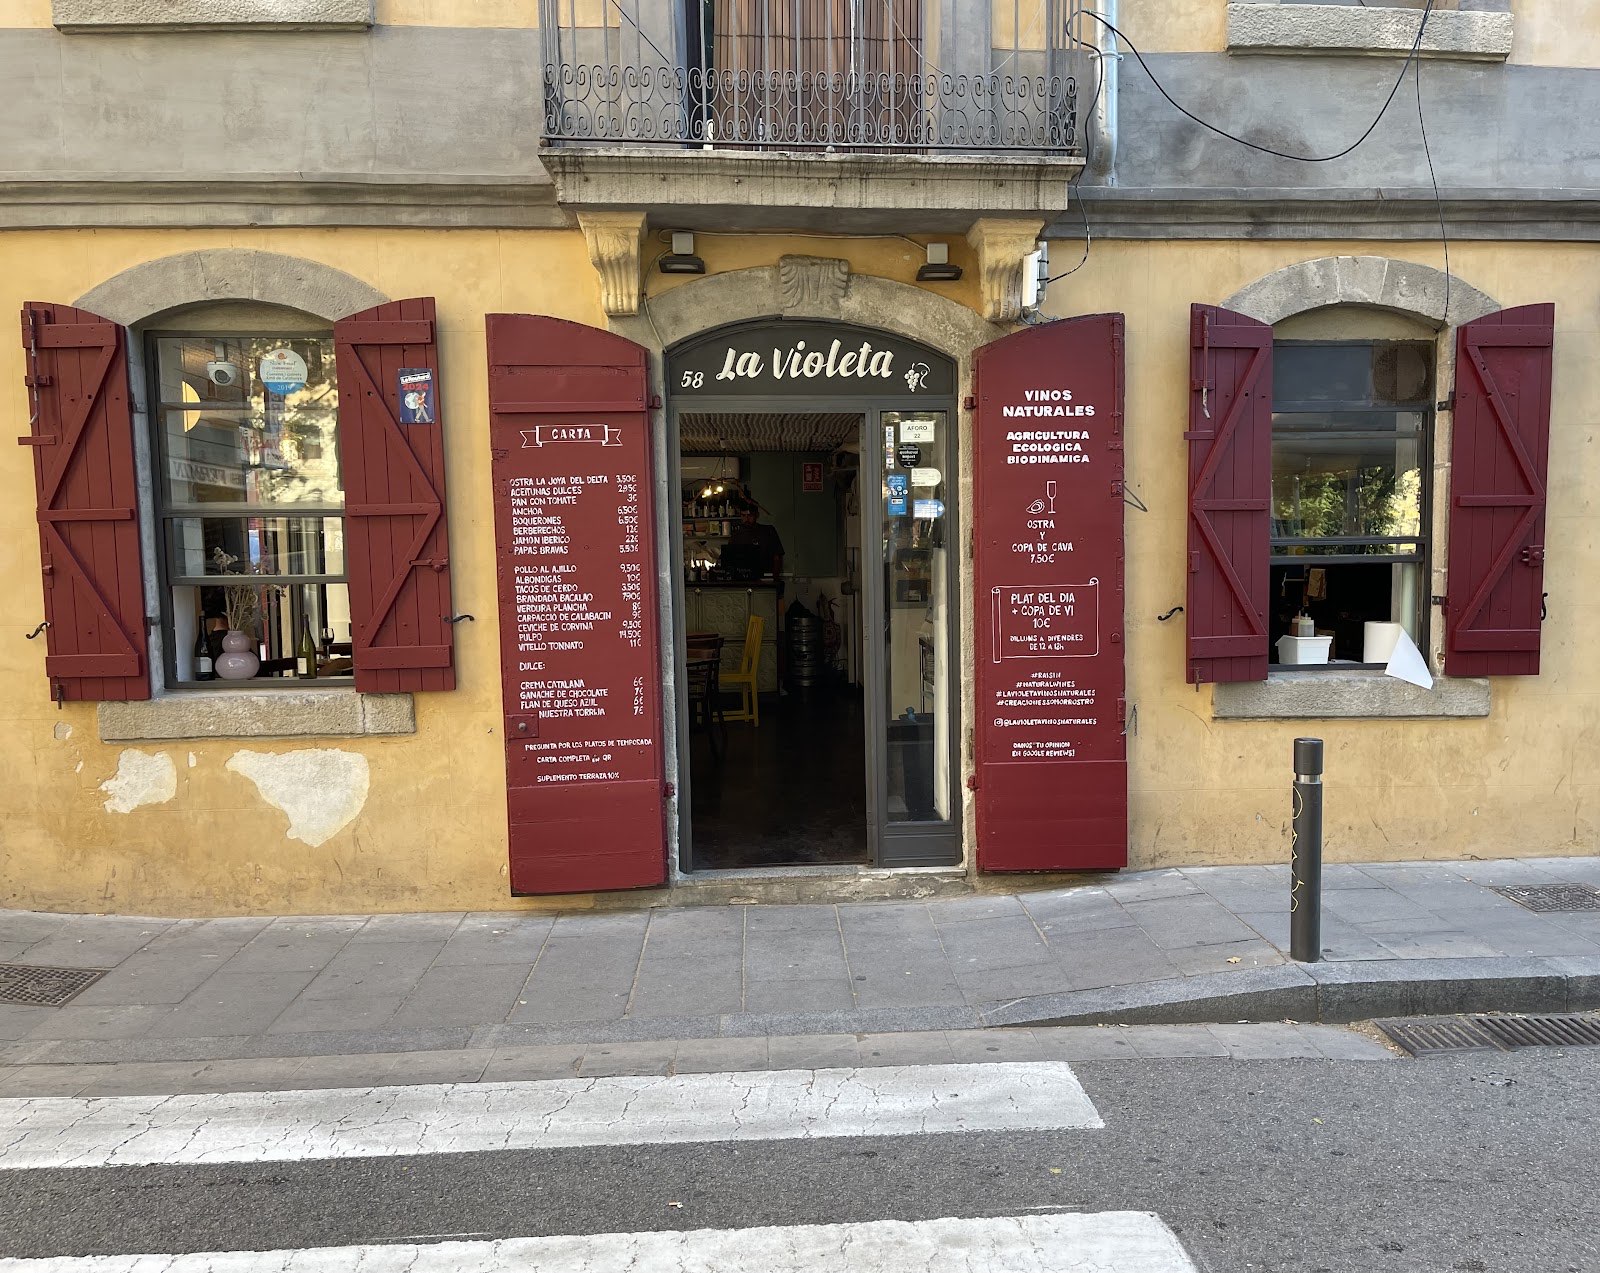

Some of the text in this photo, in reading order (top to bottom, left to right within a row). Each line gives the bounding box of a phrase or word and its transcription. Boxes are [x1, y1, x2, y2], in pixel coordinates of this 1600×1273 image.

[715, 338, 894, 381] La Violeta
[680, 370, 705, 389] 58
[1024, 390, 1073, 401] VINOS
[1002, 405, 1096, 417] NATURALES
[551, 428, 591, 440] CARTA
[1006, 431, 1090, 441] AGRICULTURA
[1012, 443, 1082, 452] ECOLOGICA
[1007, 454, 1090, 464] BIODINAMICA
[510, 478, 533, 487] OSTRA
[536, 477, 545, 485] LA
[548, 476, 566, 485] JOYA
[570, 476, 584, 484] DEL
[587, 475, 608, 484] DELTA
[510, 487, 550, 497] ACEITUNAS
[553, 486, 582, 495] DULCES
[511, 494, 638, 506] PAN CON TOMATE 3€
[512, 507, 543, 516] ANCHOA
[512, 516, 561, 526] BOQUERONES
[1027, 520, 1055, 529] OSTRA
[512, 526, 566, 535] BERBERECHOS
[1039, 531, 1046, 540] Y
[512, 535, 638, 545] JAMON IBERICO 22€
[514, 546, 538, 555] PAPAS
[540, 545, 568, 555] BRAVAS
[1011, 542, 1073, 552] COPA DE CAVA
[514, 565, 538, 574] POLLO
[540, 565, 549, 573] AL
[552, 565, 577, 573] AJILLO
[515, 573, 640, 584] ALBONDIGAS 10€
[515, 585, 539, 594] TACOS
[541, 585, 550, 593] DE
[553, 584, 578, 593] CERDO
[516, 594, 557, 604] BRANDADA
[560, 593, 593, 602] BACALAO
[1010, 592, 1075, 604] PLAT DEL DIA
[516, 604, 552, 613] VERDURA
[553, 603, 588, 612] PLANCHA
[1011, 605, 1074, 616] + COPA DE VI
[517, 613, 557, 622] CARPACCIO
[560, 613, 569, 621] DE
[571, 612, 612, 621] CALABACIN
[518, 623, 548, 633] CEVICHE
[550, 623, 559, 631] DE
[562, 622, 594, 631] CORVINA
[1032, 618, 1050, 628] 10€
[519, 633, 542, 642] PULPO
[518, 642, 547, 652] VITELLO
[548, 641, 584, 650] TONNATO
[1029, 643, 1038, 651] DE
[519, 661, 546, 671] DULCE:
[520, 676, 643, 690] CREMA CATALANA 6€
[520, 687, 643, 699] GANACHE DE CHOCOLATE 7€
[520, 696, 643, 710] FLAN DE QUESO AZUL 6€
[539, 709, 573, 718] NUESTRA
[633, 706, 643, 715] 7€
[525, 743, 557, 751] PREGUNTA
[585, 740, 606, 748] PLATOS
[558, 755, 591, 763] COMPLETA
[537, 774, 578, 783] SUPLEMENTO
[579, 772, 607, 781] TERRAZA
